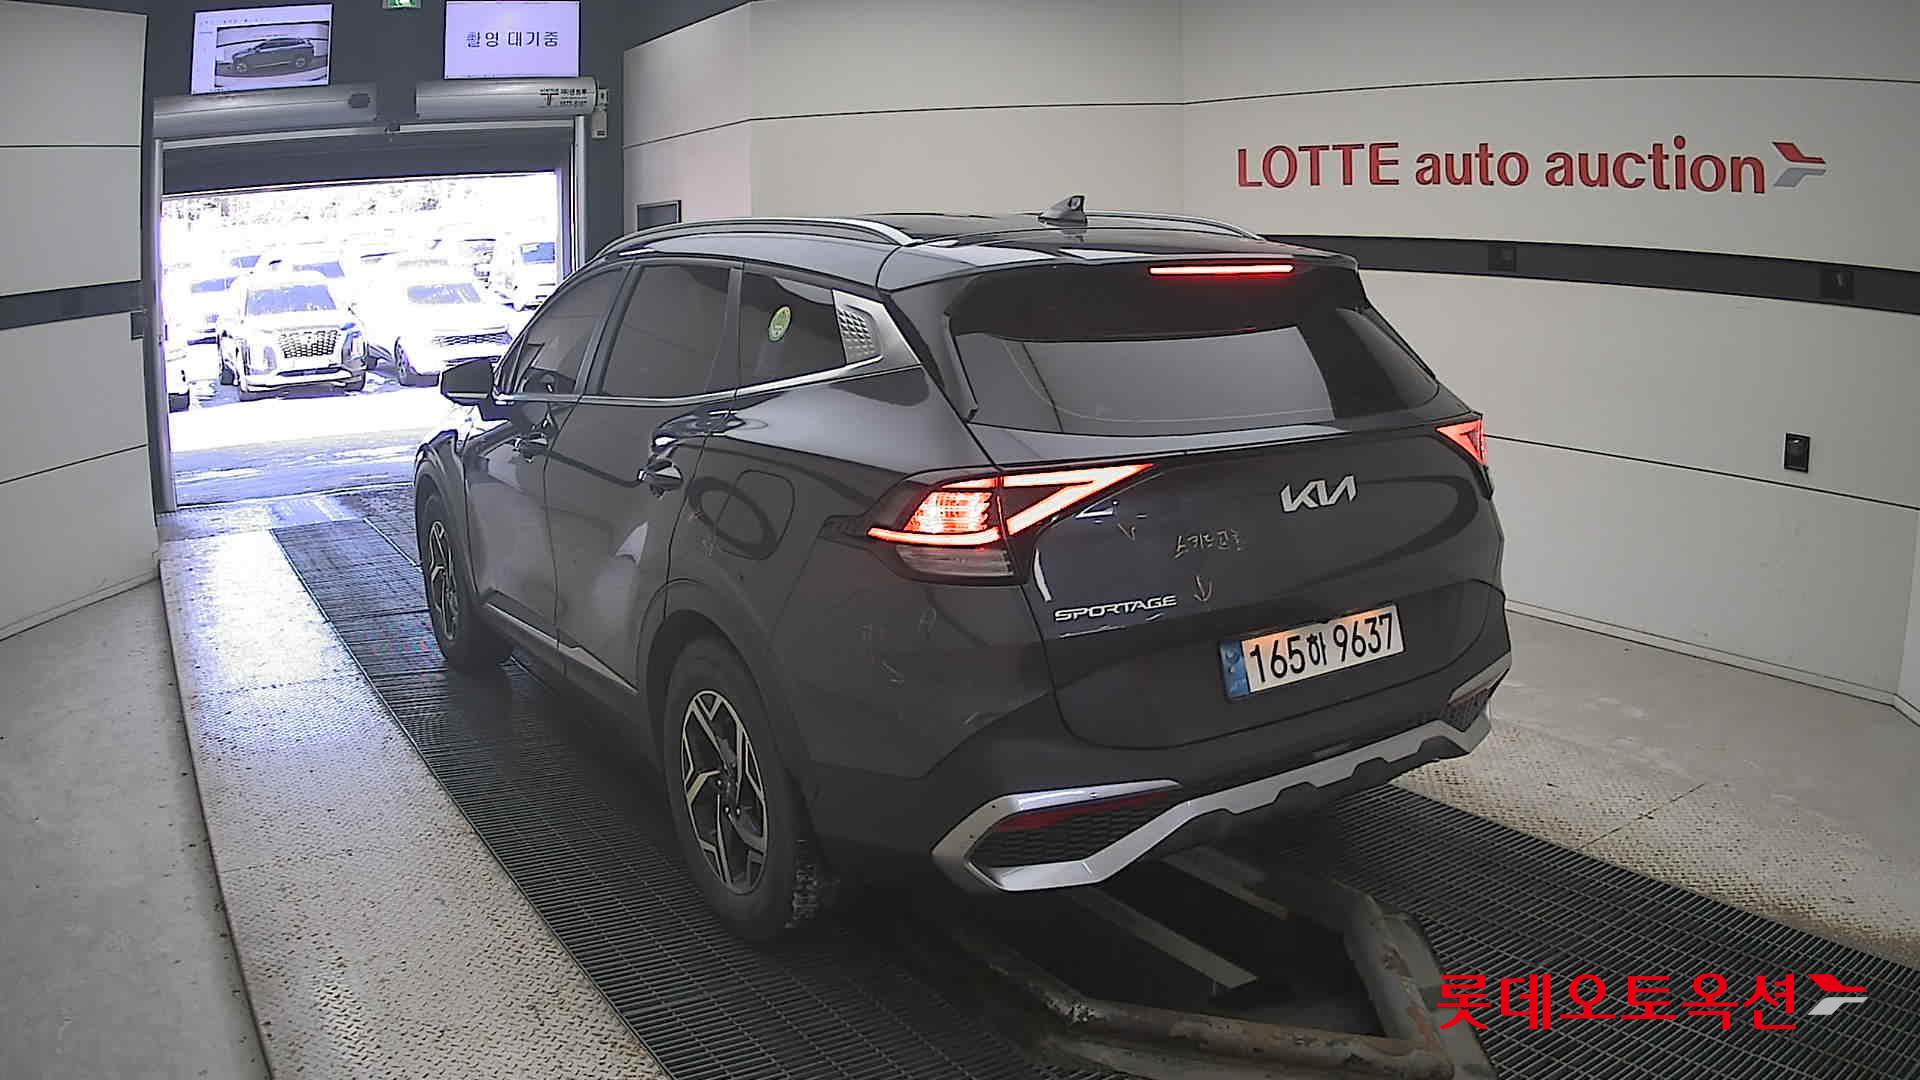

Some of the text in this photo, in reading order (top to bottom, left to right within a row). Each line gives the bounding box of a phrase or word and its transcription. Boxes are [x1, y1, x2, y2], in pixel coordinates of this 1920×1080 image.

[507, 31, 558, 48] 대기중
[1237, 135, 1765, 194] LOTTE auto auction
[1055, 595, 1177, 621] SPORTAGE
[1250, 612, 1393, 683] 165하 9637
